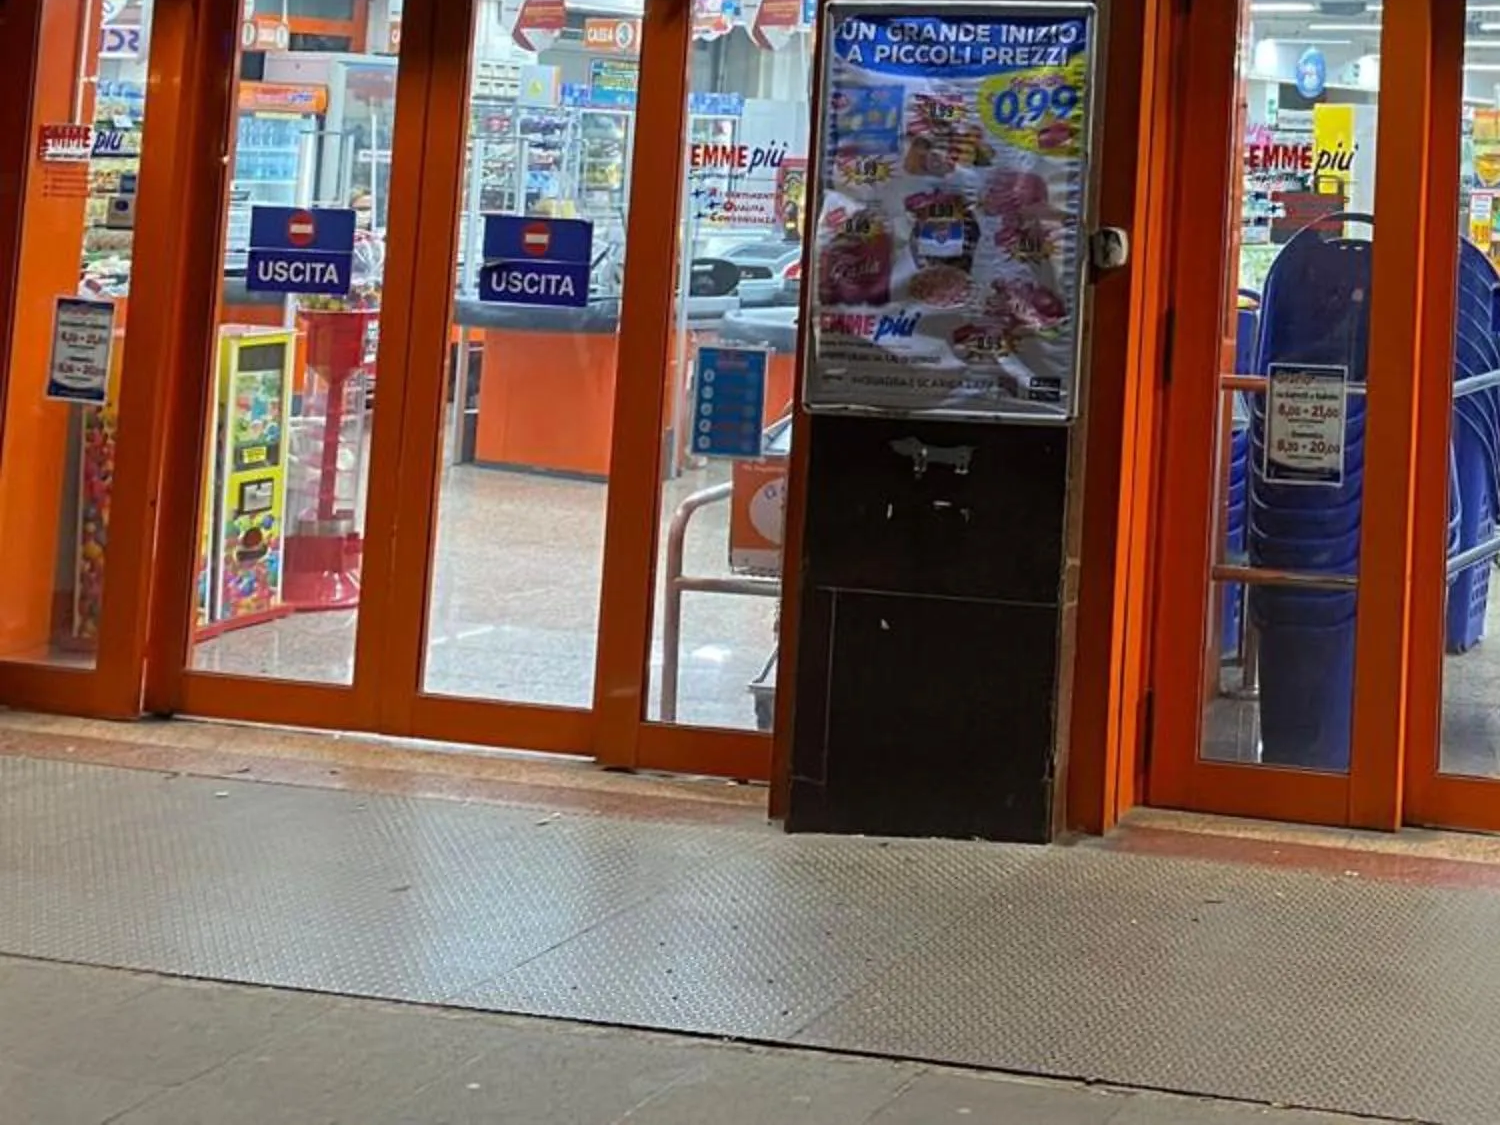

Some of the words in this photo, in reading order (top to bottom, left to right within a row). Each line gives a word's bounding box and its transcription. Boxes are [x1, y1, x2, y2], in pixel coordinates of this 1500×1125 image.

[842, 21, 877, 41] UN
[886, 24, 991, 43] GRANDE
[1000, 24, 1078, 44] INIZIO
[849, 45, 864, 63] A
[874, 44, 972, 65] PICCOLI
[981, 46, 1069, 66] PREZZI
[993, 84, 1078, 129] 0,99
[690, 143, 749, 168] EMME
[1247, 143, 1313, 169] EMME
[257, 261, 340, 284] USCITA
[490, 271, 575, 297] USCITA
